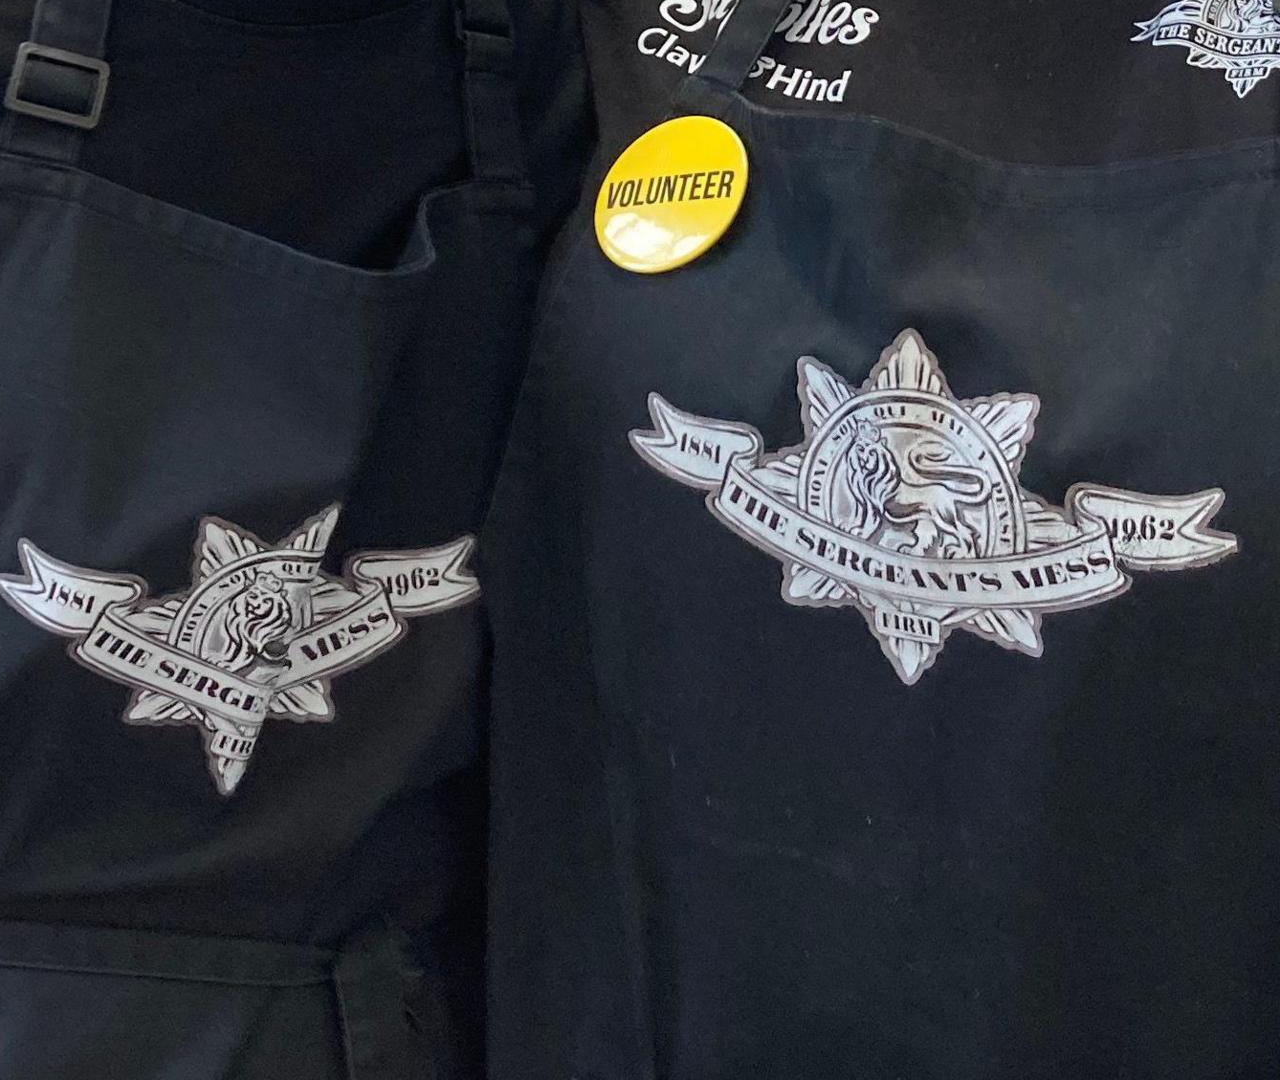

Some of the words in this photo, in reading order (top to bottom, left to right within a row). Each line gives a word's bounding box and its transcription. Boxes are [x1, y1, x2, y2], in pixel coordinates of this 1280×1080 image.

[1160, 23, 1192, 39] THE
[765, 64, 852, 102] Hind
[1230, 67, 1264, 78] FIRM
[606, 170, 735, 209] VOLUNTEER
[679, 431, 721, 465] 1881
[728, 480, 789, 537] THE
[795, 526, 1003, 593] SERGEANT'S
[1011, 549, 1112, 590] MESS
[1109, 514, 1175, 543] 1962
[45, 579, 96, 614] 1881
[384, 566, 441, 597] 1962
[882, 611, 933, 637] FIRM
[94, 627, 153, 669] THE
[155, 659, 265, 714] SERGE
[299, 607, 390, 662] MESS
[218, 735, 254, 755] FIR
